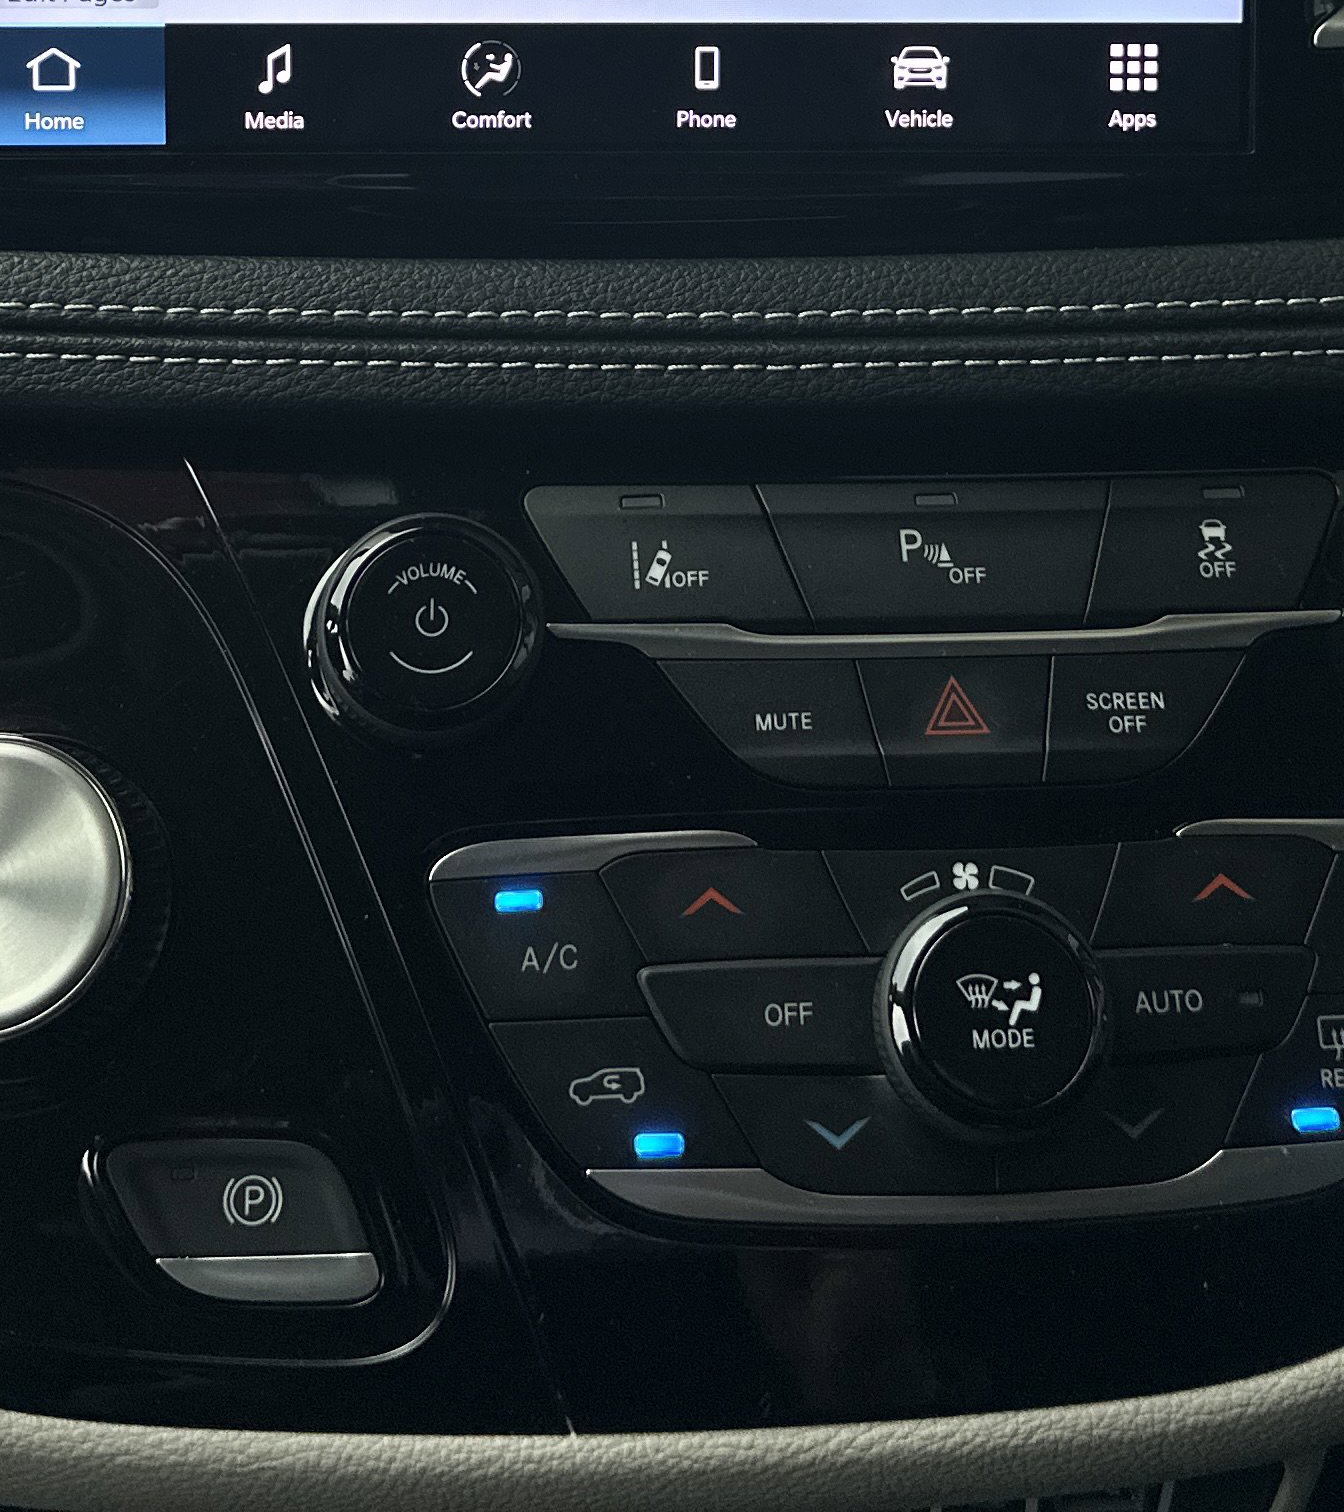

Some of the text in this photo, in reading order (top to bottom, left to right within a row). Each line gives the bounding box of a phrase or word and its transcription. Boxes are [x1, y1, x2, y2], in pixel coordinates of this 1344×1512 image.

[24, 112, 85, 130] Home
[244, 110, 305, 130] Media
[451, 109, 532, 129] Comfort
[676, 109, 737, 129] Phone
[884, 109, 954, 128] Vehicle
[1108, 109, 1157, 132] Apps
[394, 561, 468, 588] VOLUME
[671, 570, 709, 588] OFF
[948, 566, 987, 584] OFF
[1199, 561, 1236, 578] OFF
[1086, 691, 1165, 710] SCREEN
[755, 712, 813, 731] MUTE
[1108, 715, 1147, 734] OFF
[521, 942, 578, 974] A/C
[1135, 989, 1203, 1014] AUTO
[764, 1001, 813, 1027] OFF
[972, 1028, 1035, 1049] MODE
